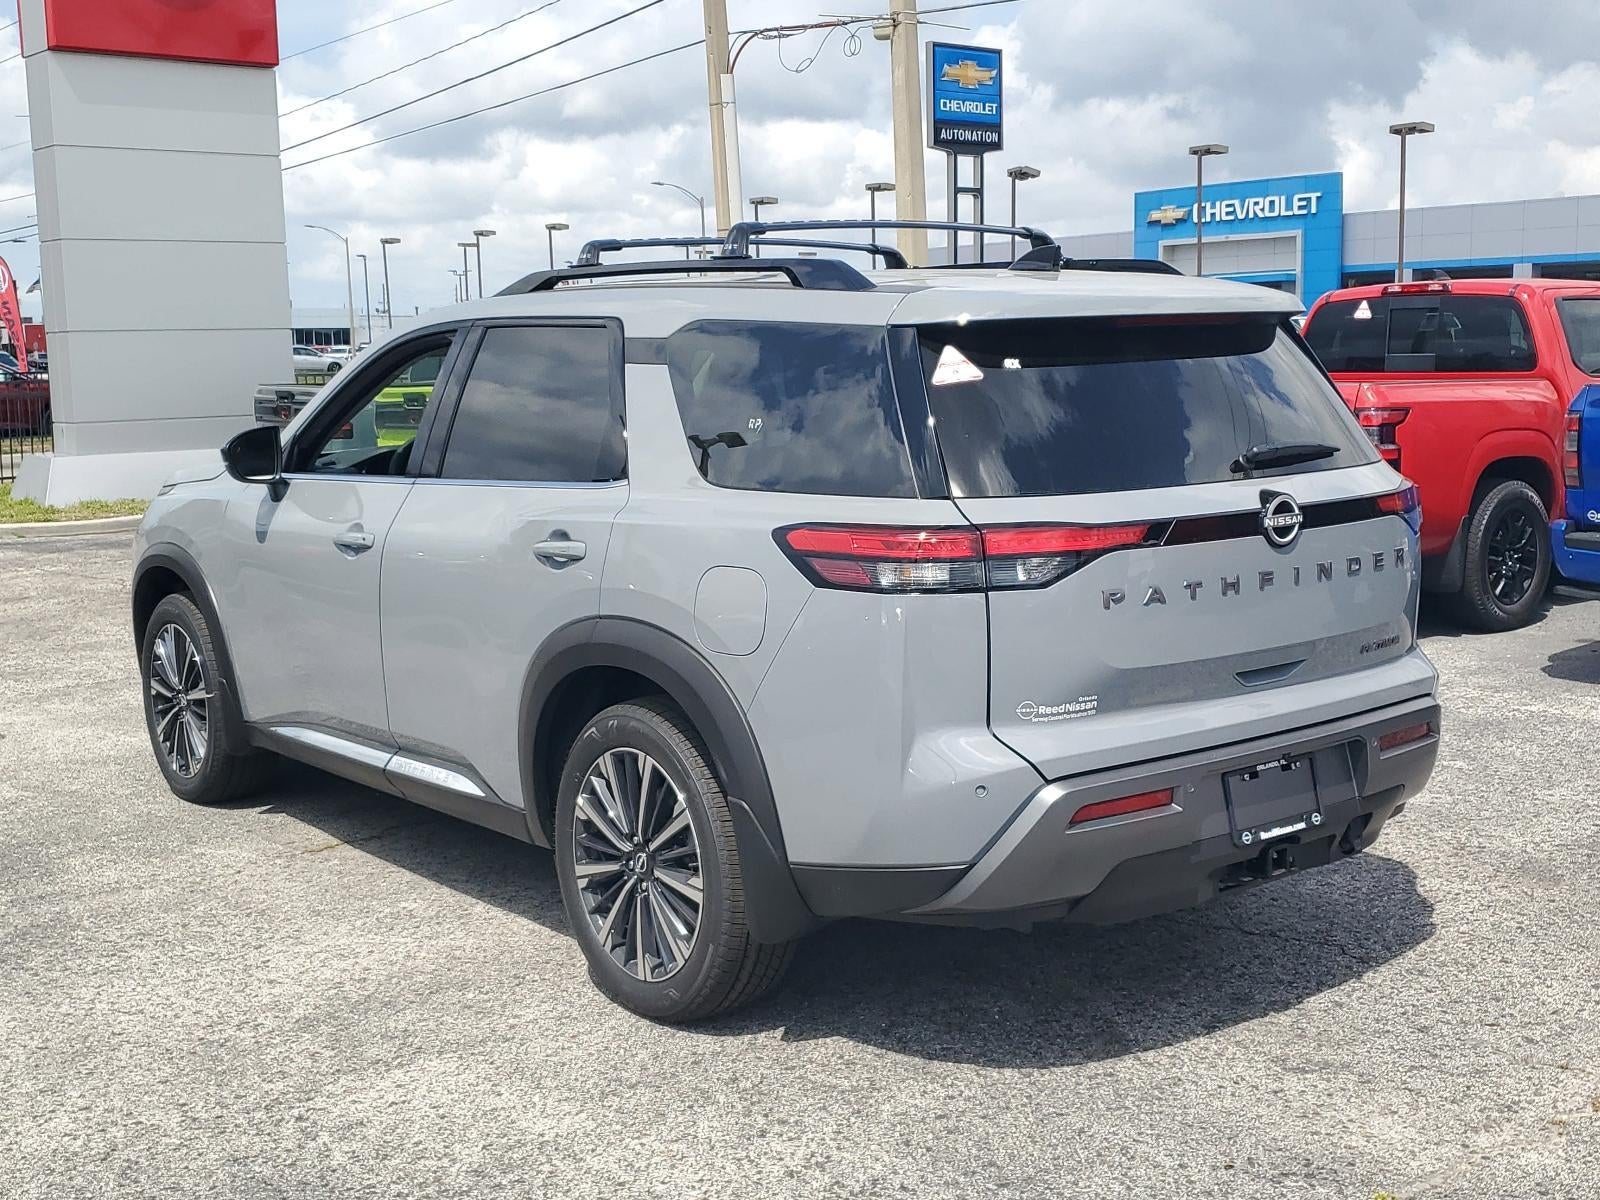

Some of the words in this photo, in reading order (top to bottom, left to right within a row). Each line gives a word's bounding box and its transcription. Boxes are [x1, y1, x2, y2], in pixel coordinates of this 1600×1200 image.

[940, 99, 998, 115] CHEVROLET
[940, 128, 999, 142] AUTONATION
[1192, 192, 1322, 224] CHEVROLET
[1264, 514, 1303, 528] NISSAN
[1102, 547, 1405, 610] PATHFINDER
